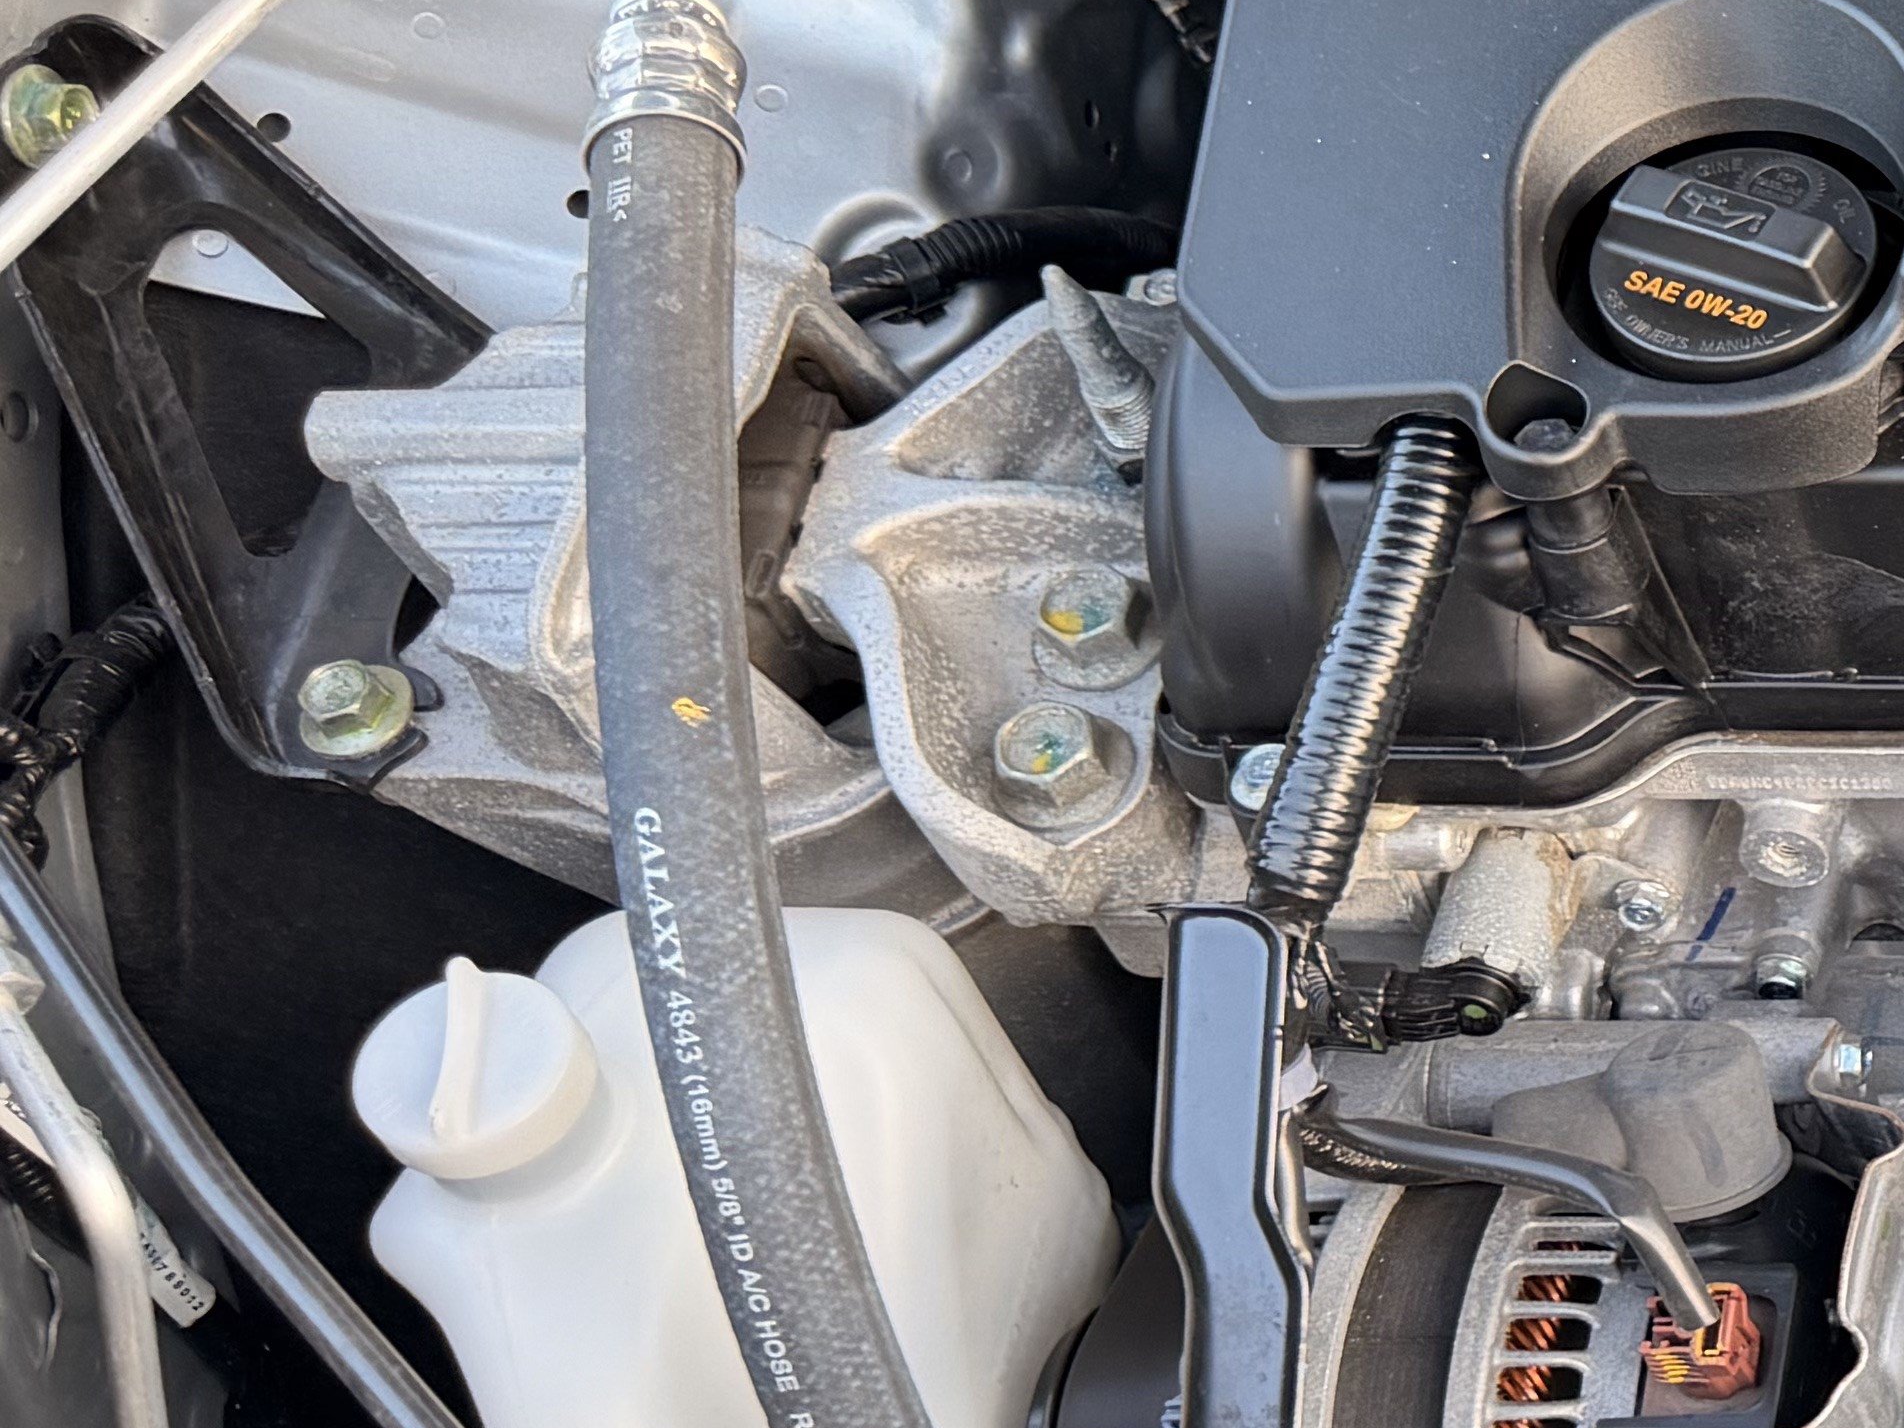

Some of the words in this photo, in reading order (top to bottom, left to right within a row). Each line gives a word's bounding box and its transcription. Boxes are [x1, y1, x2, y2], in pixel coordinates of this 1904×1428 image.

[612, 127, 634, 163] PET
[1623, 270, 1686, 305] SAE
[1684, 288, 1768, 331] 0W-20
[1625, 313, 1691, 352] OWNER'S
[1698, 330, 1776, 354] MANUAL
[634, 807, 687, 980] GALAXY
[665, 990, 705, 1065] 4843
[680, 1073, 729, 1172] (16mm)
[711, 1176, 746, 1227] 5/8"
[726, 1230, 755, 1263] ID
[737, 1268, 772, 1313] A/C
[754, 1319, 801, 1394] HOSE
